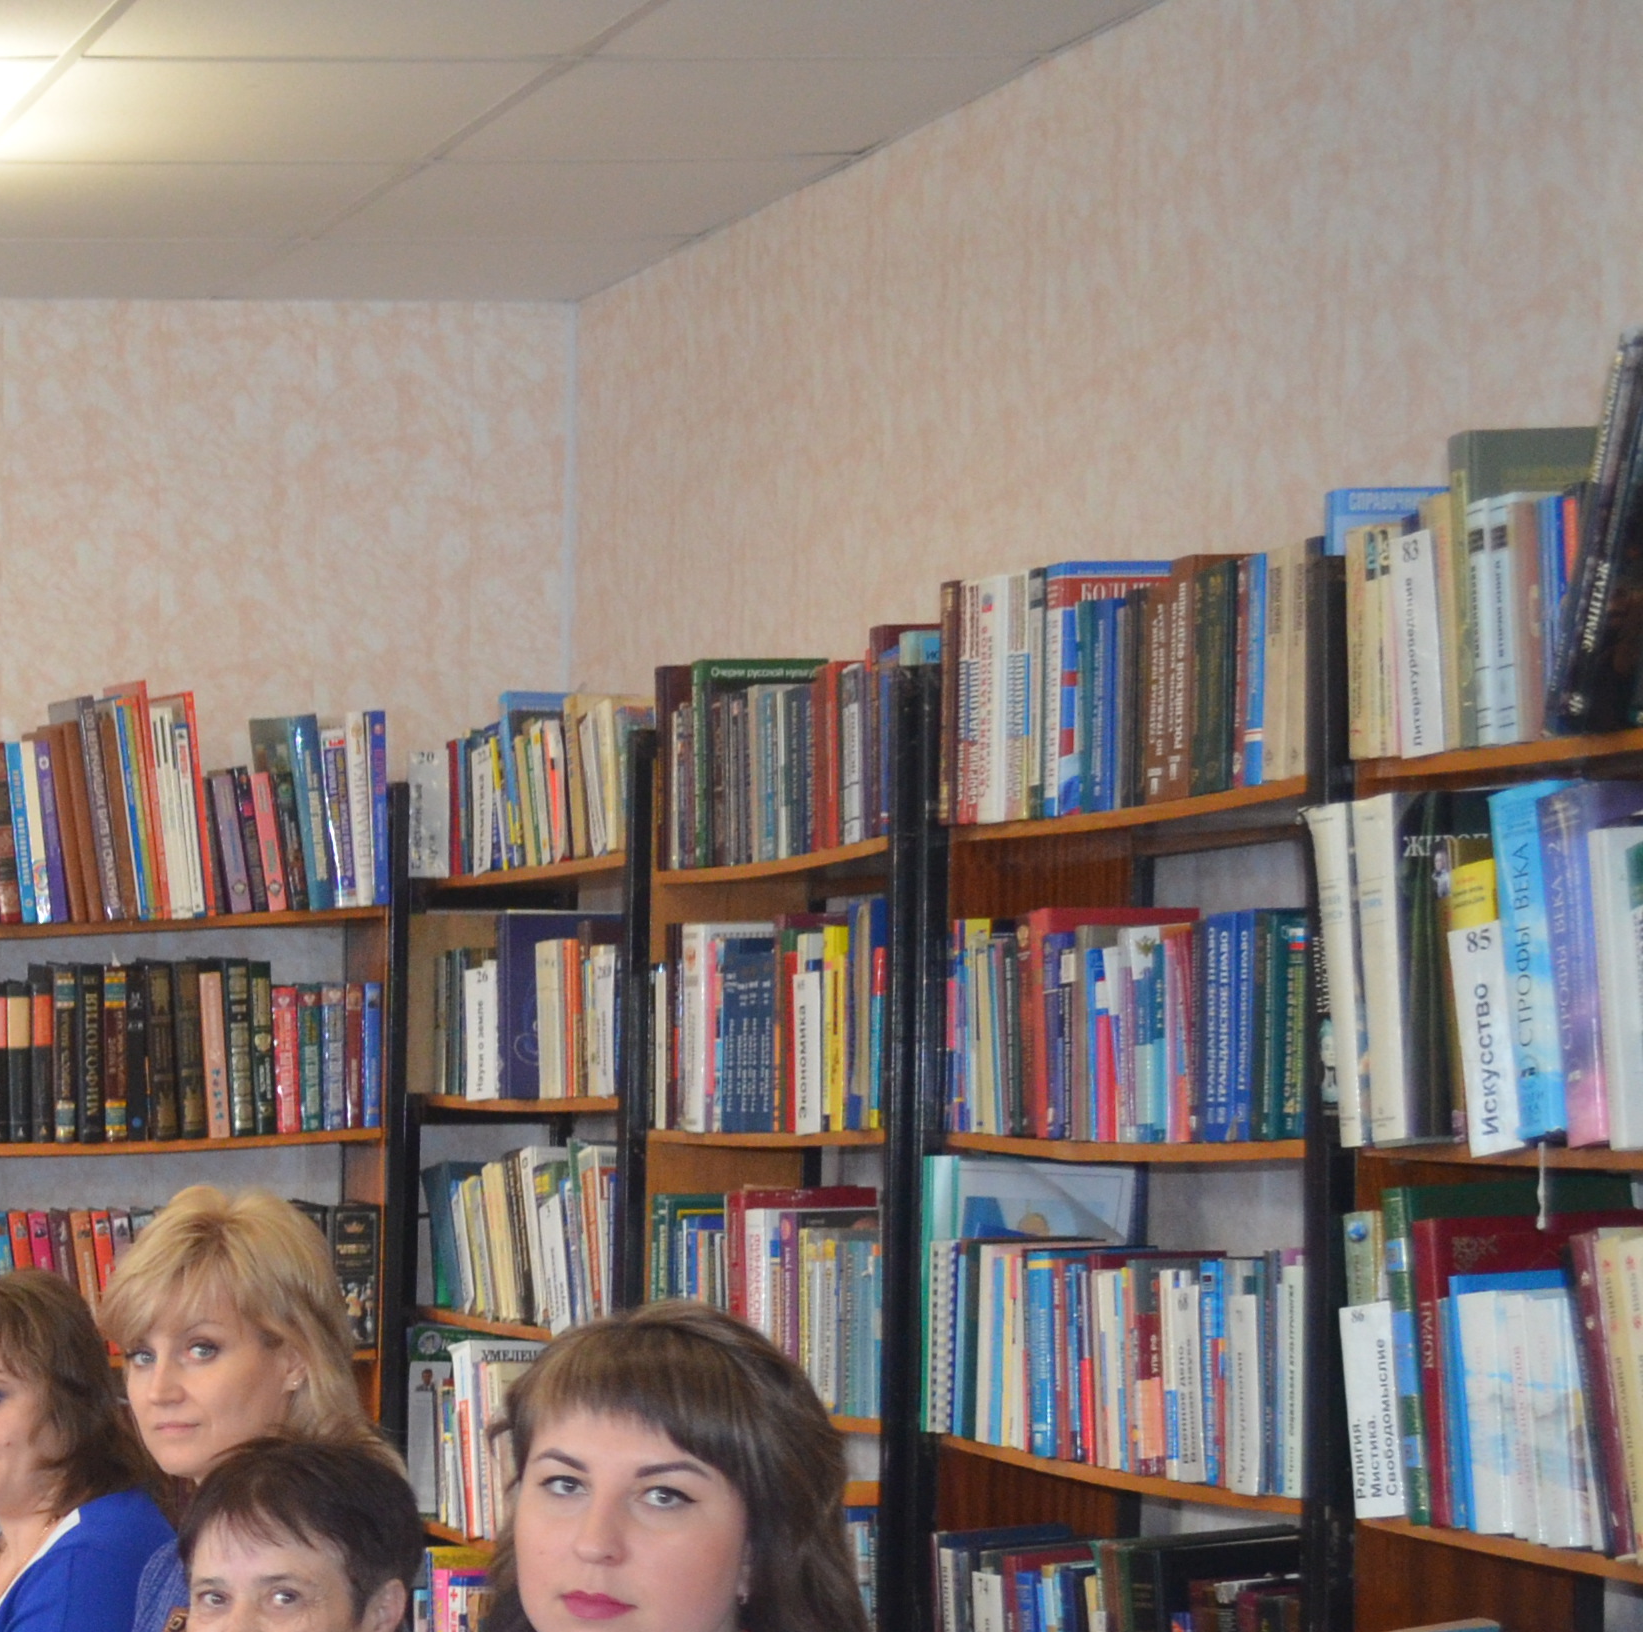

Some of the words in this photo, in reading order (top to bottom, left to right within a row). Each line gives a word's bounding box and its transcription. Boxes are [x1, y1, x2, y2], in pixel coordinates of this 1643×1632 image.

[1402, 538, 1419, 563] 83
[1175, 582, 1187, 662] ФЕДЕРАЦИИ
[1579, 559, 1611, 653] ЭРМИТАЖ
[745, 668, 782, 682] русской
[967, 660, 980, 740] ЗАКОНОВ
[1403, 577, 1423, 747] Литературоведение
[1175, 664, 1185, 750] РОССИЙСКОЙ
[417, 751, 435, 765] 20
[353, 761, 371, 871] ГЕРАЛЬДИКА
[1511, 841, 1530, 910] ВЕКА
[1550, 875, 1567, 934] ВЕКА
[475, 970, 489, 983] 26
[1204, 927, 1215, 983] ПРАВО
[1217, 930, 1229, 984] ПРАВО
[1237, 930, 1249, 984] ПРАВО
[1467, 930, 1492, 954] 85
[475, 999, 485, 1037] земле
[1512, 926, 1535, 1047] СТРОФЫ
[1555, 943, 1573, 1050] СТРОФЫ
[84, 991, 100, 1116] МИФОЛОГИЯ
[475, 1055, 486, 1092] Науки
[796, 1004, 808, 1119] Экономика
[1217, 986, 1229, 1103] ГРАЖДАНСКОЕ
[1236, 987, 1249, 1091] ГРАЖДАНСКОЕ
[1475, 983, 1500, 1135] Искусство
[1350, 1309, 1365, 1324] 86
[1421, 1301, 1434, 1369] КОРАН
[1376, 1337, 1399, 1497] Свободомыслие
[1615, 1356, 1634, 1453] ПРАВОСЛАВНАЯ
[1352, 1418, 1367, 1499] Религия.
[1366, 1415, 1382, 1499] Мистика.
